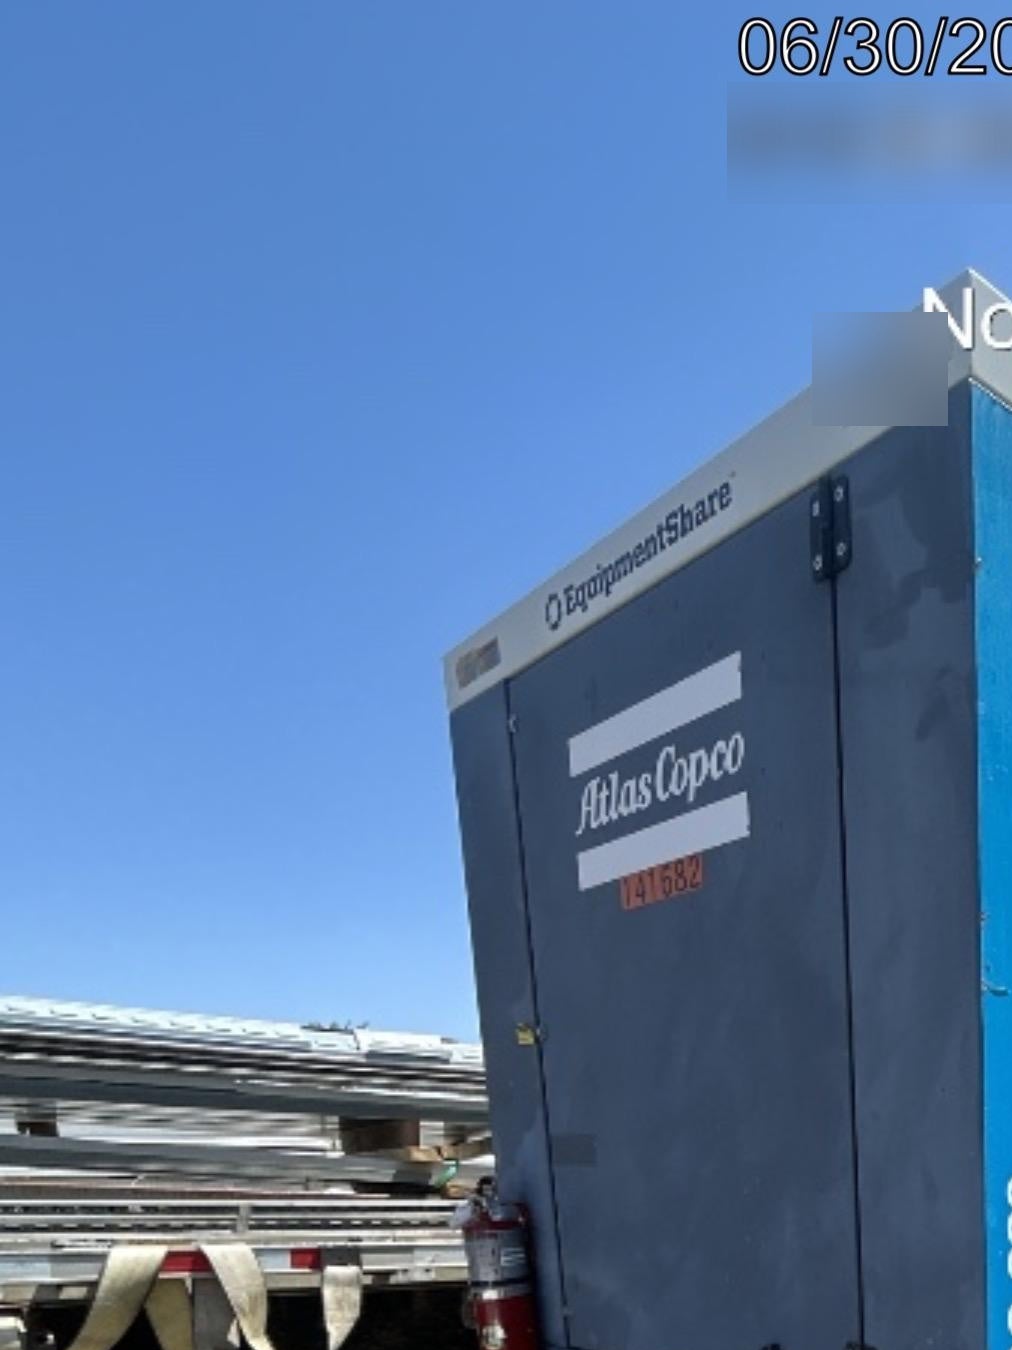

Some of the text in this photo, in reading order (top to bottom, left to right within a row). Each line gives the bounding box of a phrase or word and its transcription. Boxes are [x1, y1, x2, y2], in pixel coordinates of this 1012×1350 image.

[564, 482, 732, 615] EquipmentShare
[575, 732, 745, 835] Atlas Copco
[622, 854, 701, 907] 141682
